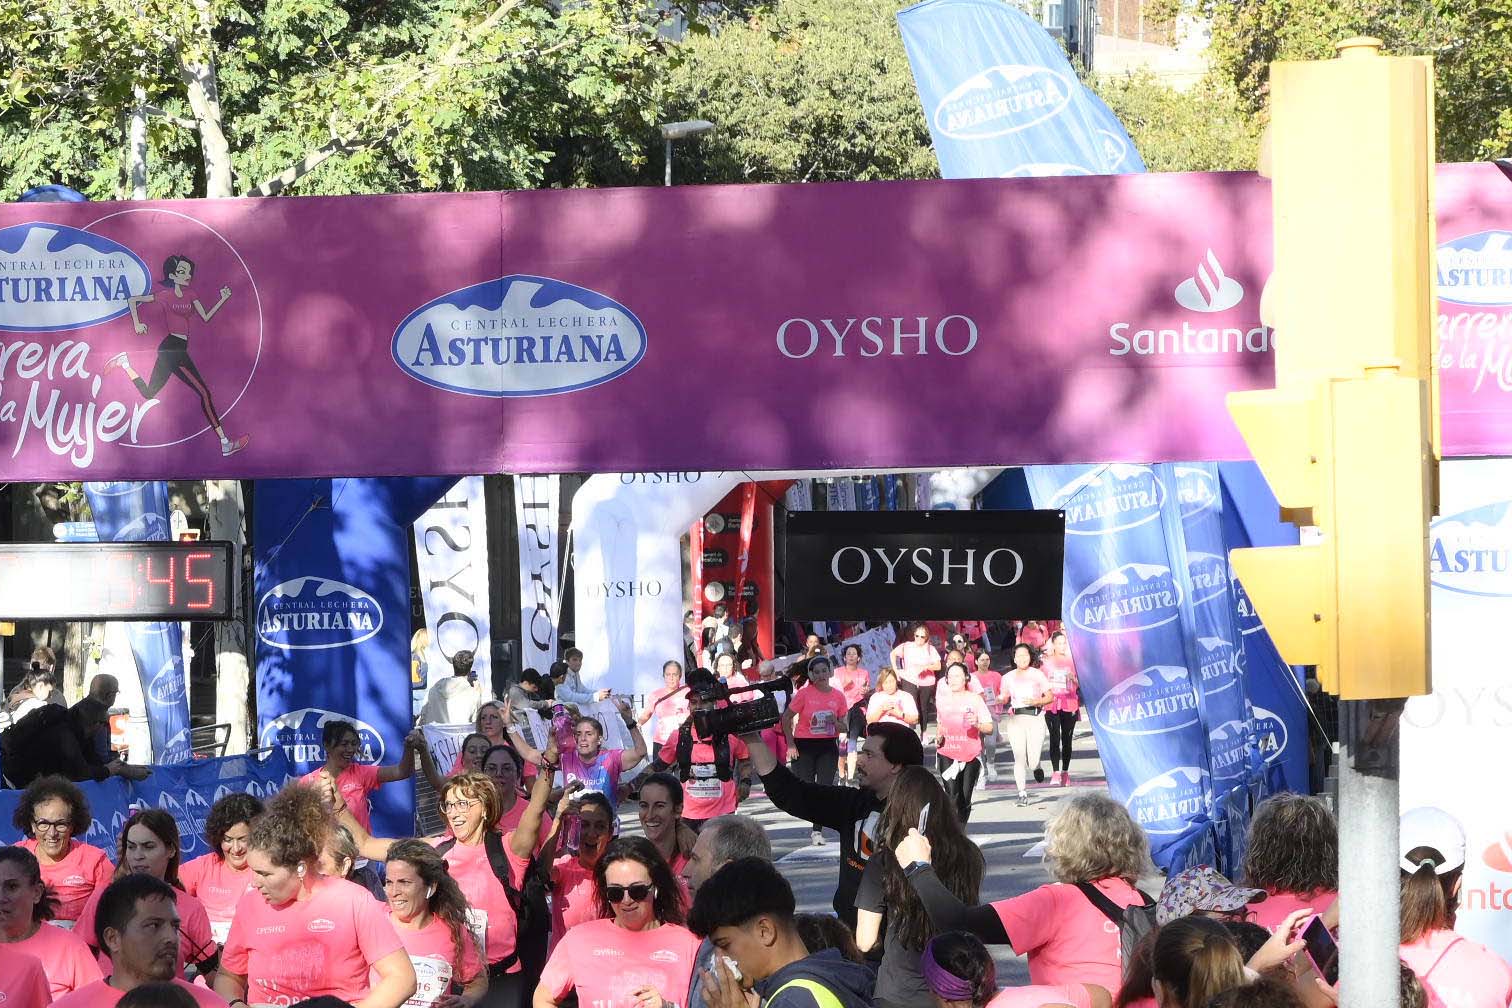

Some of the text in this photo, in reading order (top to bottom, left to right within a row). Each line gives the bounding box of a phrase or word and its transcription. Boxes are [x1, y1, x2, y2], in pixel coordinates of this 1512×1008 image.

[54, 257, 125, 270] LECHERA
[451, 315, 618, 330] CENTRAL LECHERA
[776, 314, 978, 358] OYSHO
[411, 322, 627, 366] ASTURIANA
[12, 373, 161, 468] Mujer
[831, 546, 1024, 587] OYSHO
[585, 580, 663, 598] OYSHO
[260, 605, 374, 634] ASTURIANA
[273, 600, 370, 610] CENTRAL LECHERA
[1402, 687, 1512, 729] OYS
[417, 982, 431, 992] 16
